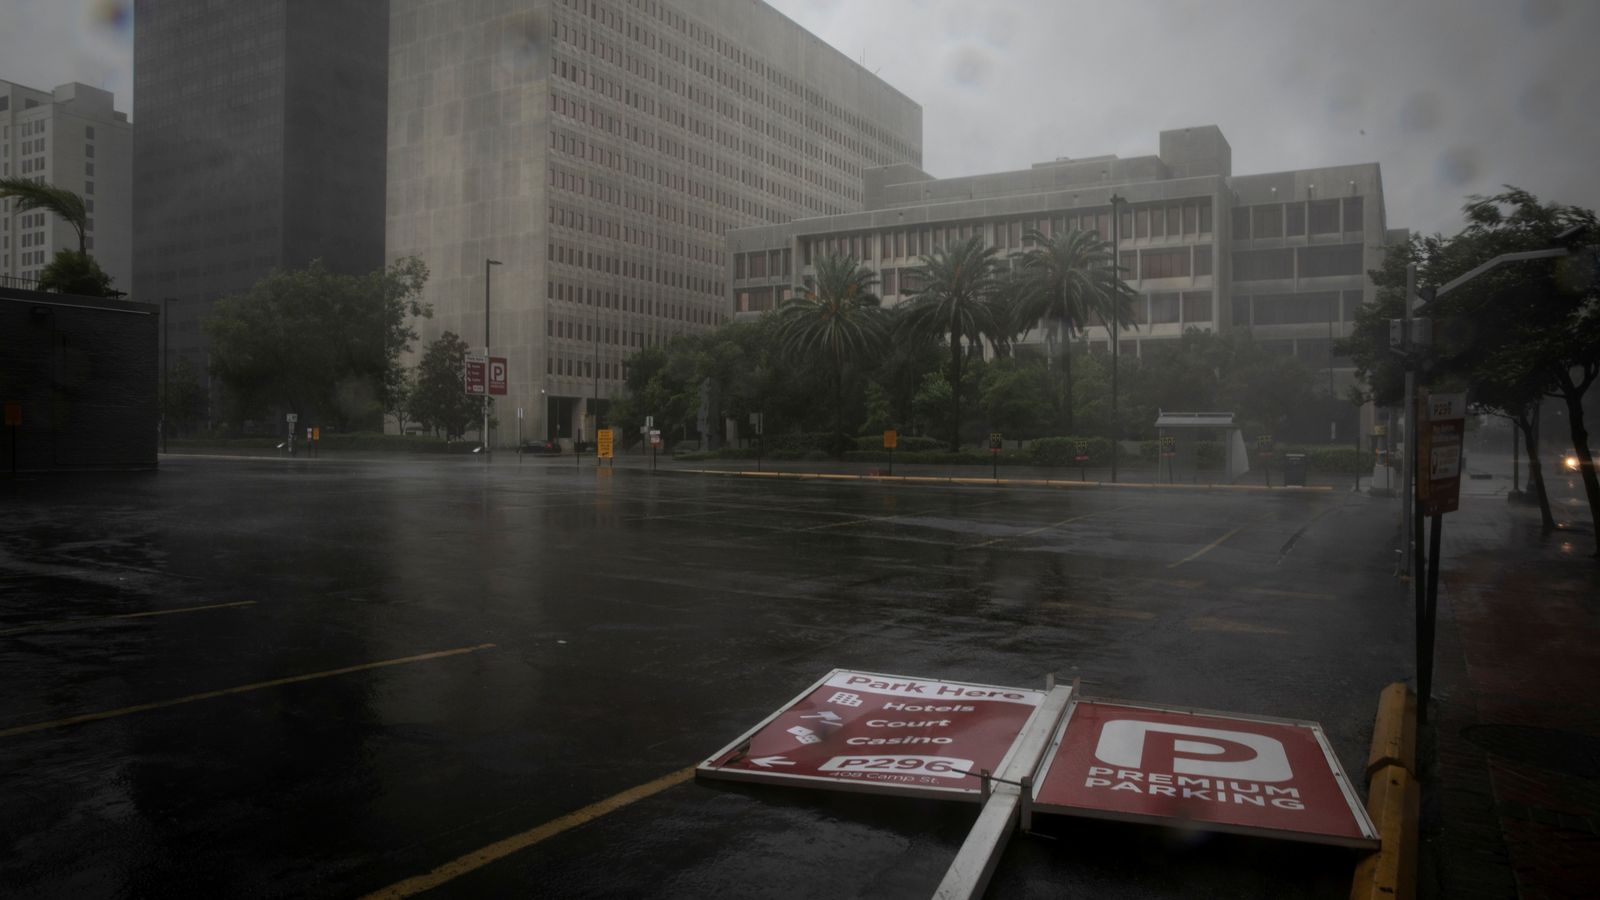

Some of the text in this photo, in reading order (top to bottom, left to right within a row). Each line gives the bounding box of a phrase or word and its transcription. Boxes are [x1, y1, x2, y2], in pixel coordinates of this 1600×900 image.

[847, 675, 1026, 701] Park Here
[882, 702, 976, 714] Hotels
[866, 717, 952, 729] Court
[846, 735, 954, 747] Casino
[838, 757, 955, 774] P296
[828, 770, 941, 785] 408 Camp St.
[1088, 766, 1301, 798] PREMIUM
[1084, 777, 1306, 811] PARKING
